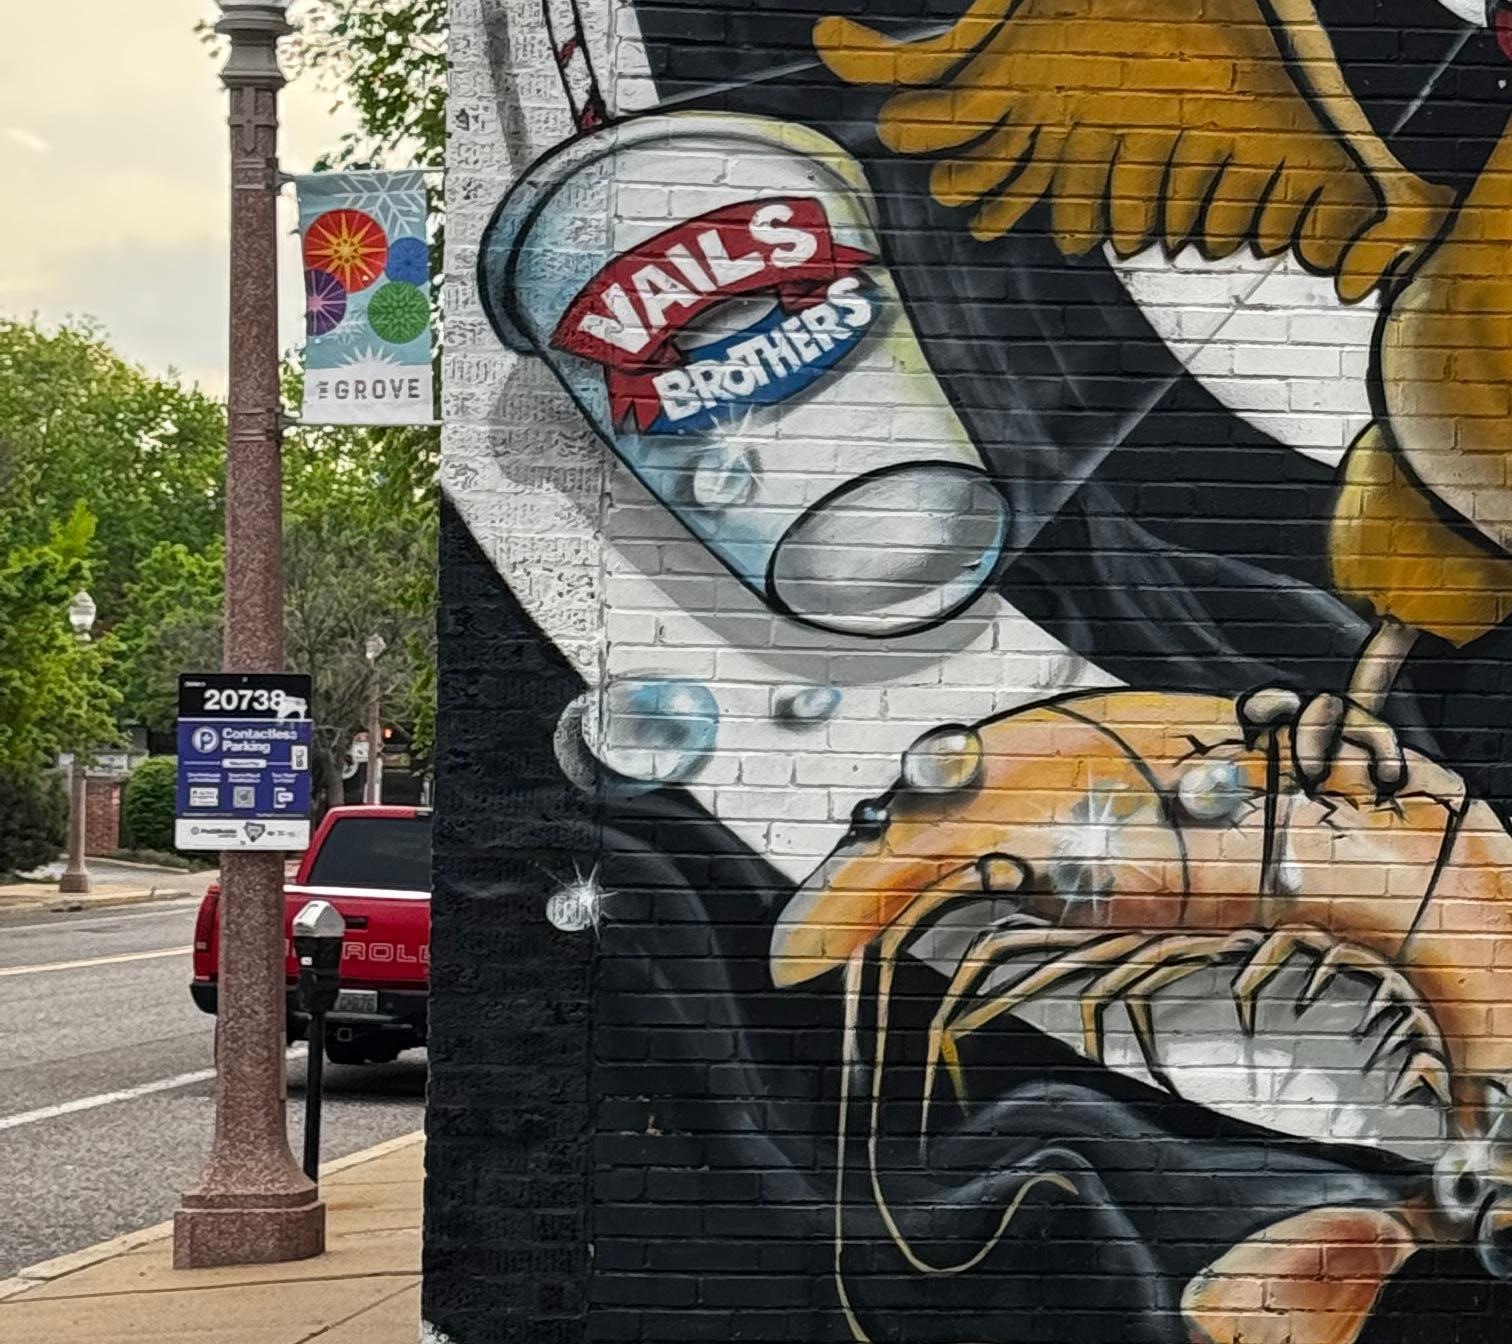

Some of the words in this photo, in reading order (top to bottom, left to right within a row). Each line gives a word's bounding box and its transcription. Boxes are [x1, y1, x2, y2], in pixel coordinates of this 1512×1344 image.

[576, 203, 817, 354] VAILS
[652, 276, 872, 422] BROTHERS
[334, 378, 420, 400] GROVE
[203, 689, 287, 711] 20738
[222, 727, 298, 741] Contactless
[222, 741, 271, 754] Parking
